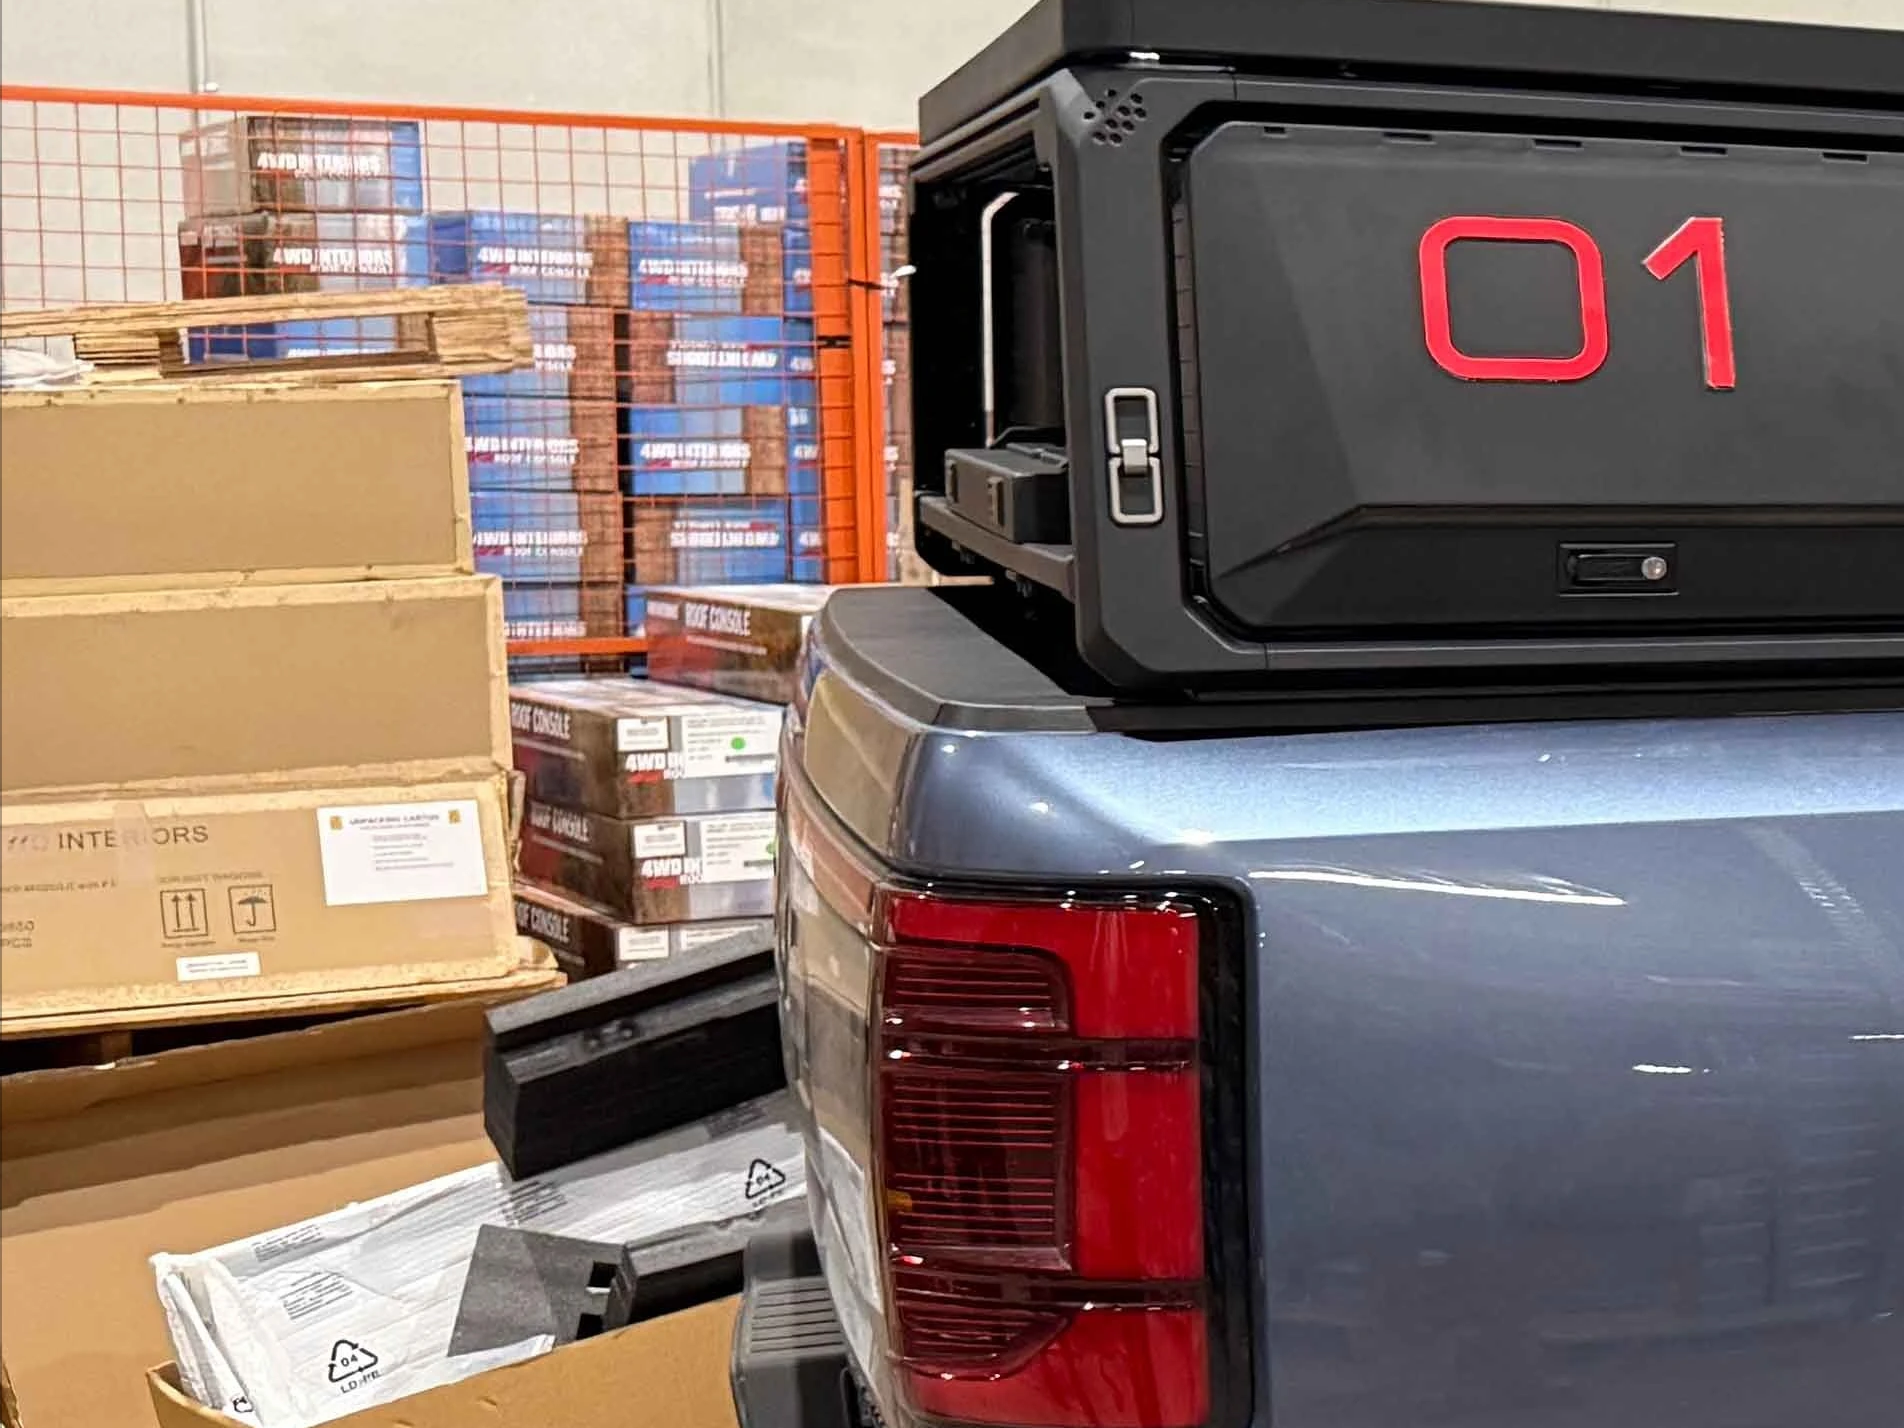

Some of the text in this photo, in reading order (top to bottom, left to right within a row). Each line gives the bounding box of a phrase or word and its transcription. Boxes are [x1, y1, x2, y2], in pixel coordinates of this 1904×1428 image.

[1418, 215, 1737, 390] 01
[685, 602, 709, 630] ROOF
[709, 604, 752, 636] CONSOLE
[532, 706, 572, 740] CONSOLE
[625, 752, 666, 772] 4WD
[641, 858, 682, 877] 4WD
[340, 1354, 359, 1368] 04
